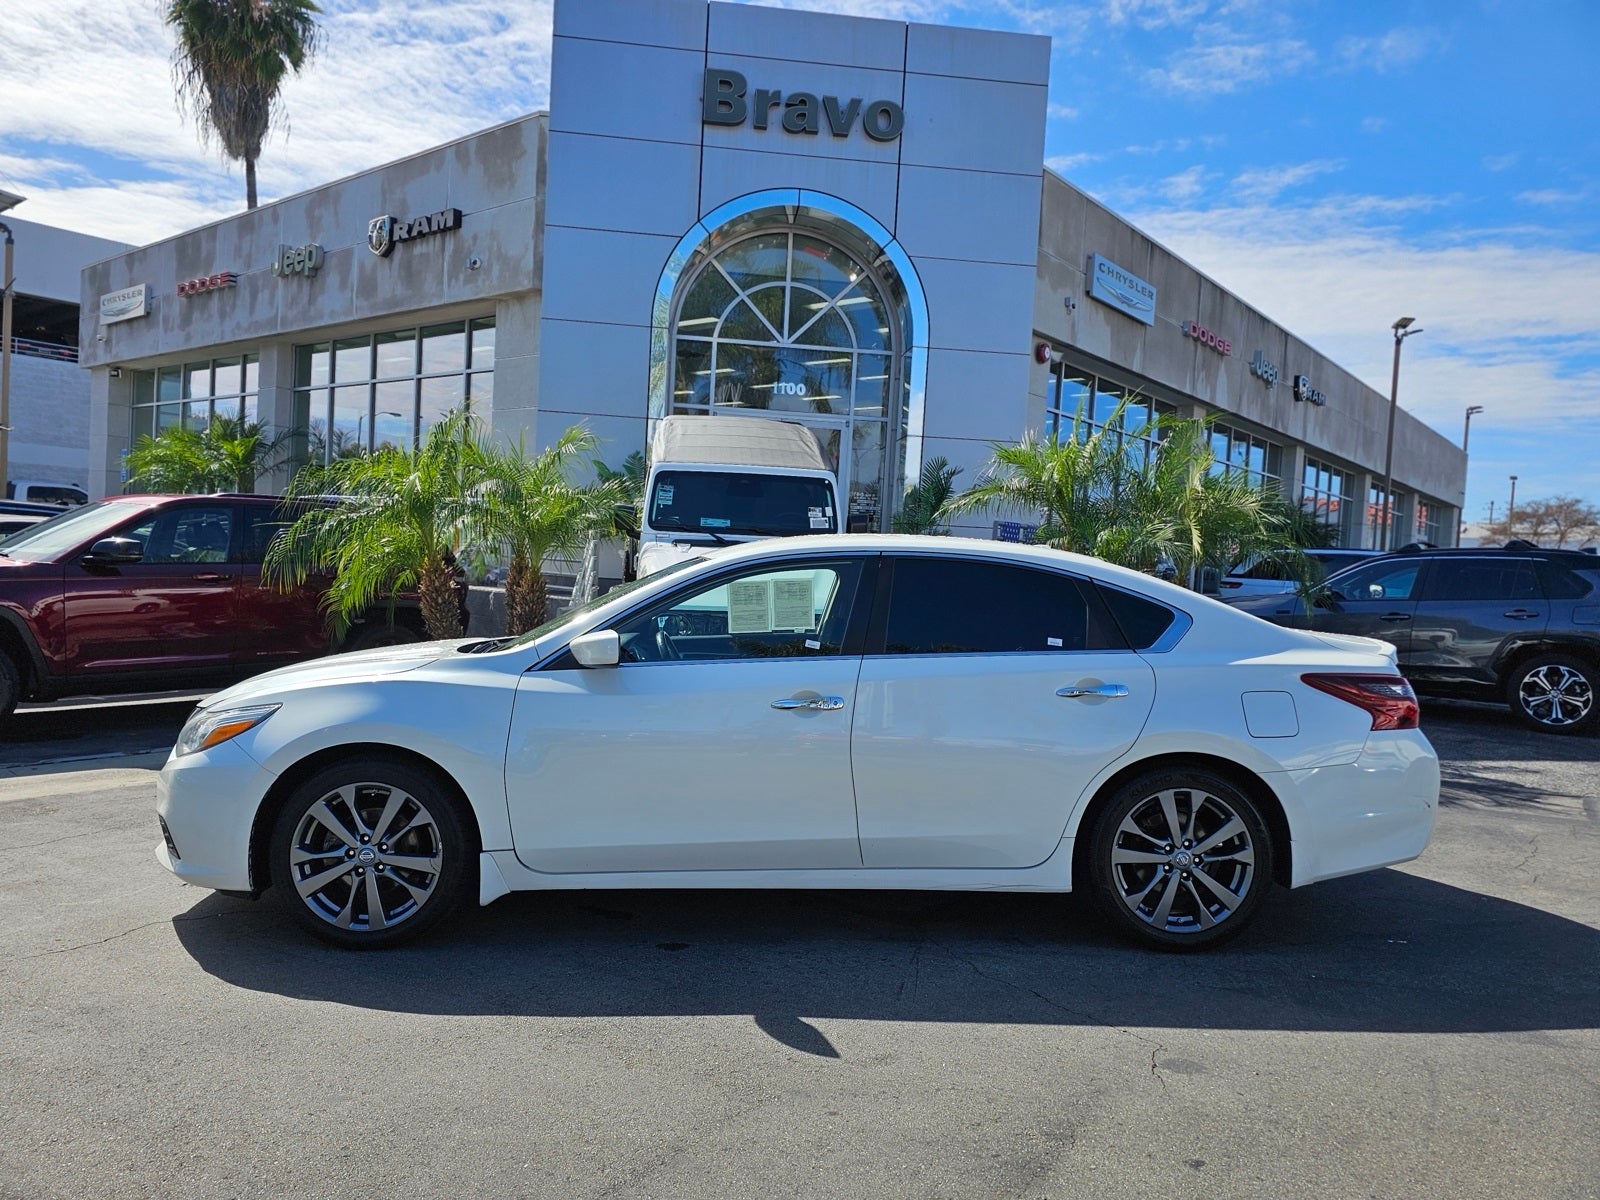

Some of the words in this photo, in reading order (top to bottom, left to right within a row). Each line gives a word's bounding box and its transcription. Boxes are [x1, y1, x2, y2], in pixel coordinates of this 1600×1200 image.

[704, 68, 905, 142] Bravo
[393, 208, 456, 241] RAM
[271, 243, 320, 277] Jeep
[102, 288, 143, 307] CHRYSLER
[177, 272, 232, 297] DODGE
[1098, 262, 1154, 301] CHRYSLER
[1189, 321, 1232, 356] DODGE
[1255, 350, 1280, 389] Jeep
[773, 381, 806, 396] 1100
[1306, 387, 1327, 406] RAM
